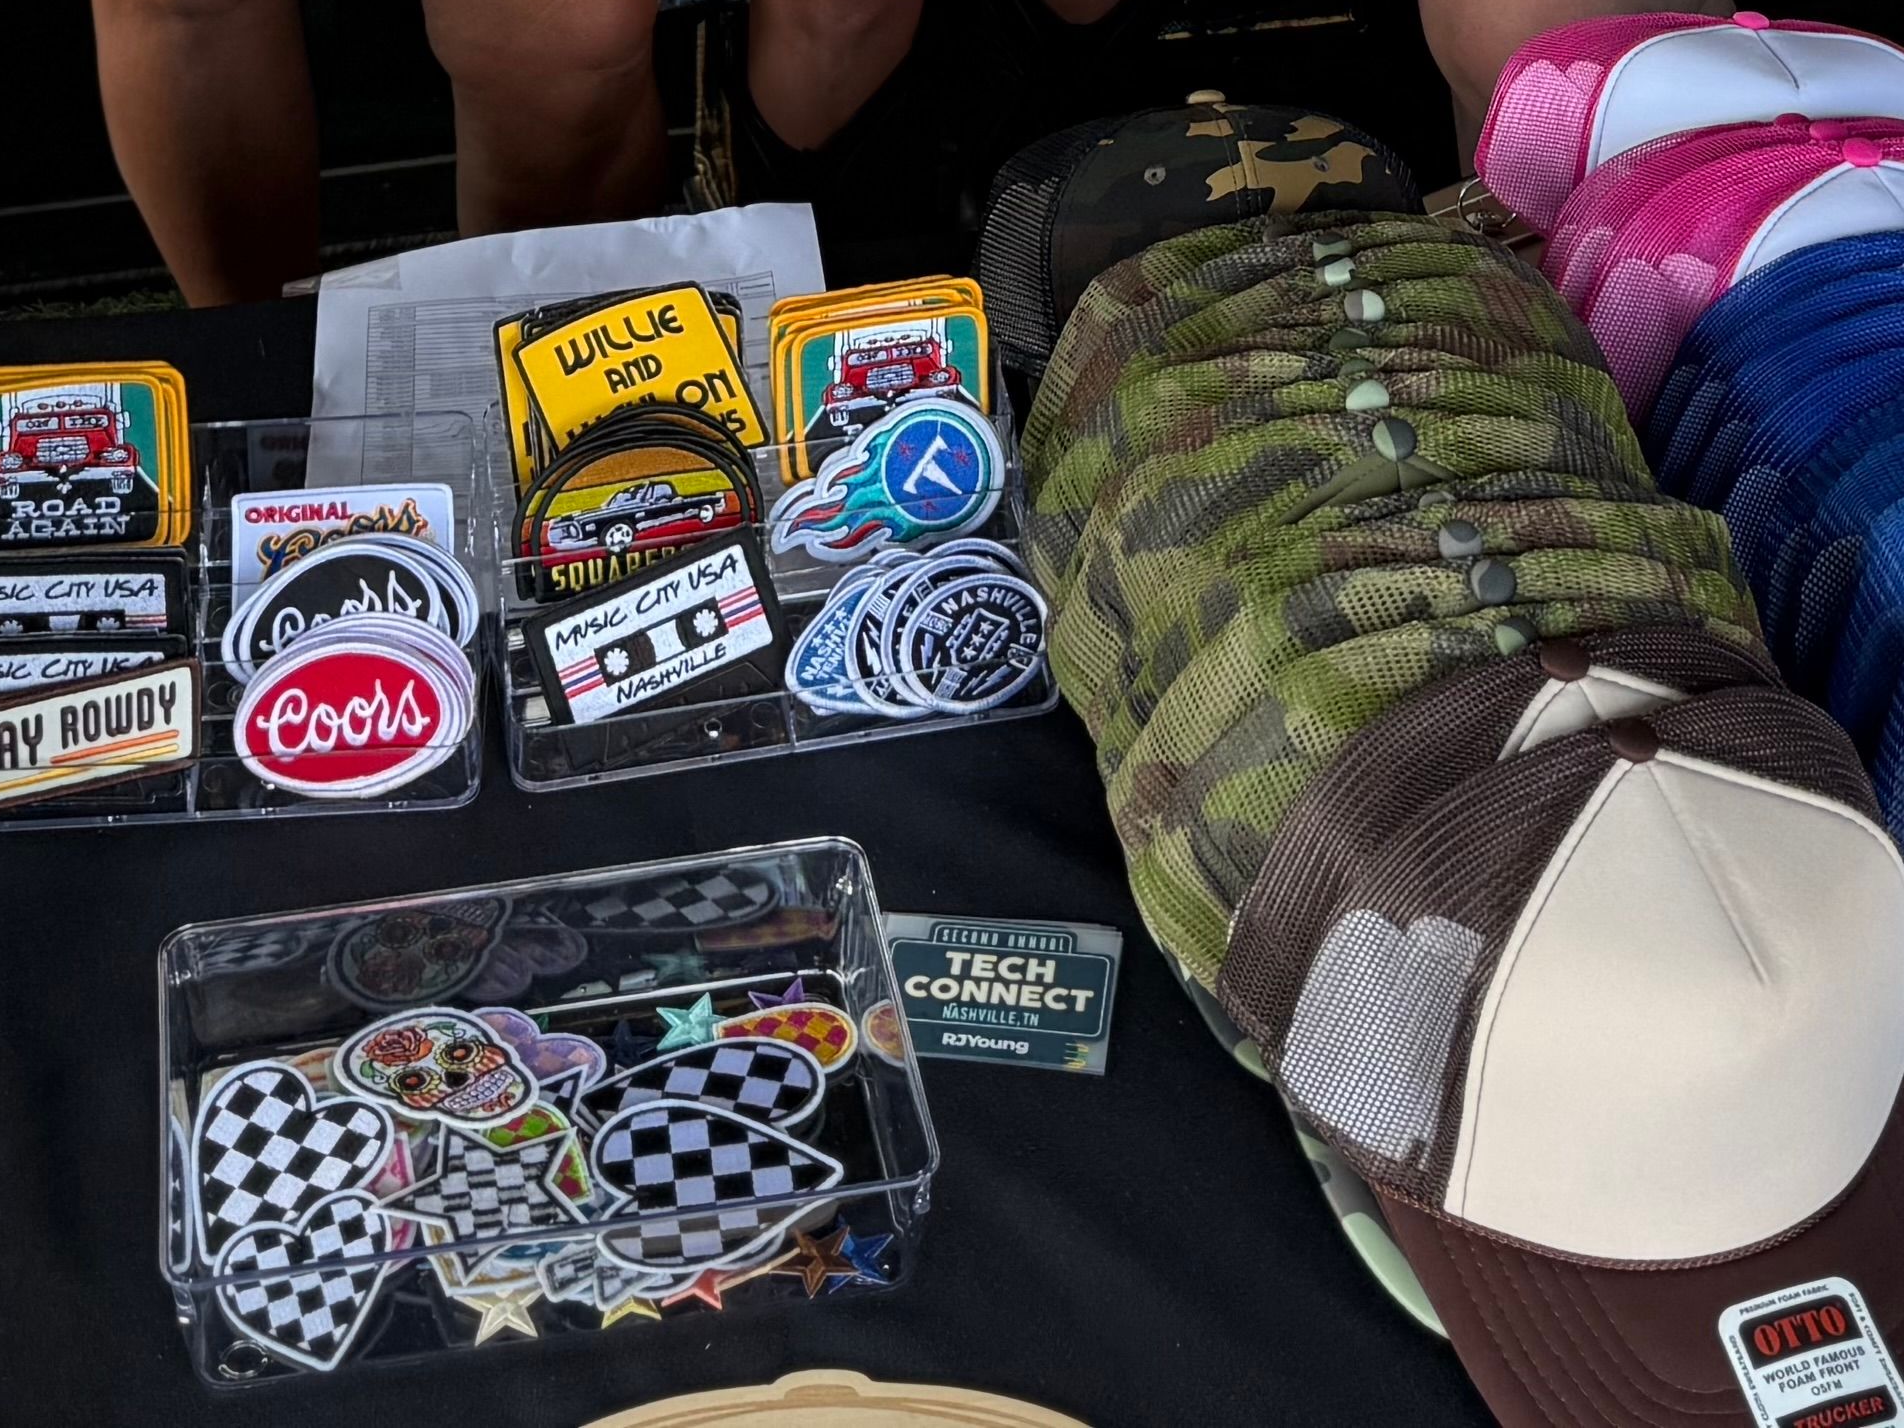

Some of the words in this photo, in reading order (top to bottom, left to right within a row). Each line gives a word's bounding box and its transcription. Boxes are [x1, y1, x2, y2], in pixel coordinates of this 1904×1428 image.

[553, 303, 685, 377] WILLIE
[603, 353, 663, 394] AND
[10, 496, 121, 519] ROAD
[244, 500, 353, 524] ORIGINAL
[0, 513, 132, 540] AGAIN
[44, 579, 96, 601] CITY
[103, 578, 159, 599] USA
[555, 607, 628, 651] MUSIC
[635, 579, 681, 615] CITY
[687, 553, 739, 591] USA
[941, 586, 1037, 644] NASHVILLE
[40, 658, 94, 680] CITY
[616, 642, 728, 704] NASHVILLE
[60, 680, 177, 750] ROWDY
[256, 678, 432, 763] Coors
[941, 928, 998, 945] SECOND
[945, 950, 1057, 984] TECH
[904, 974, 1094, 1012] CONNECT
[941, 1032, 1030, 1055] RJYoung
[1753, 1304, 1847, 1357] OTTO
[1762, 1357, 1811, 1386] WORLD
[1813, 1345, 1867, 1372] FAMOUS
[1778, 1369, 1817, 1394] FOAM
[1819, 1358, 1862, 1381] FRONT
[1793, 1395, 1886, 1428] TRUCKER
